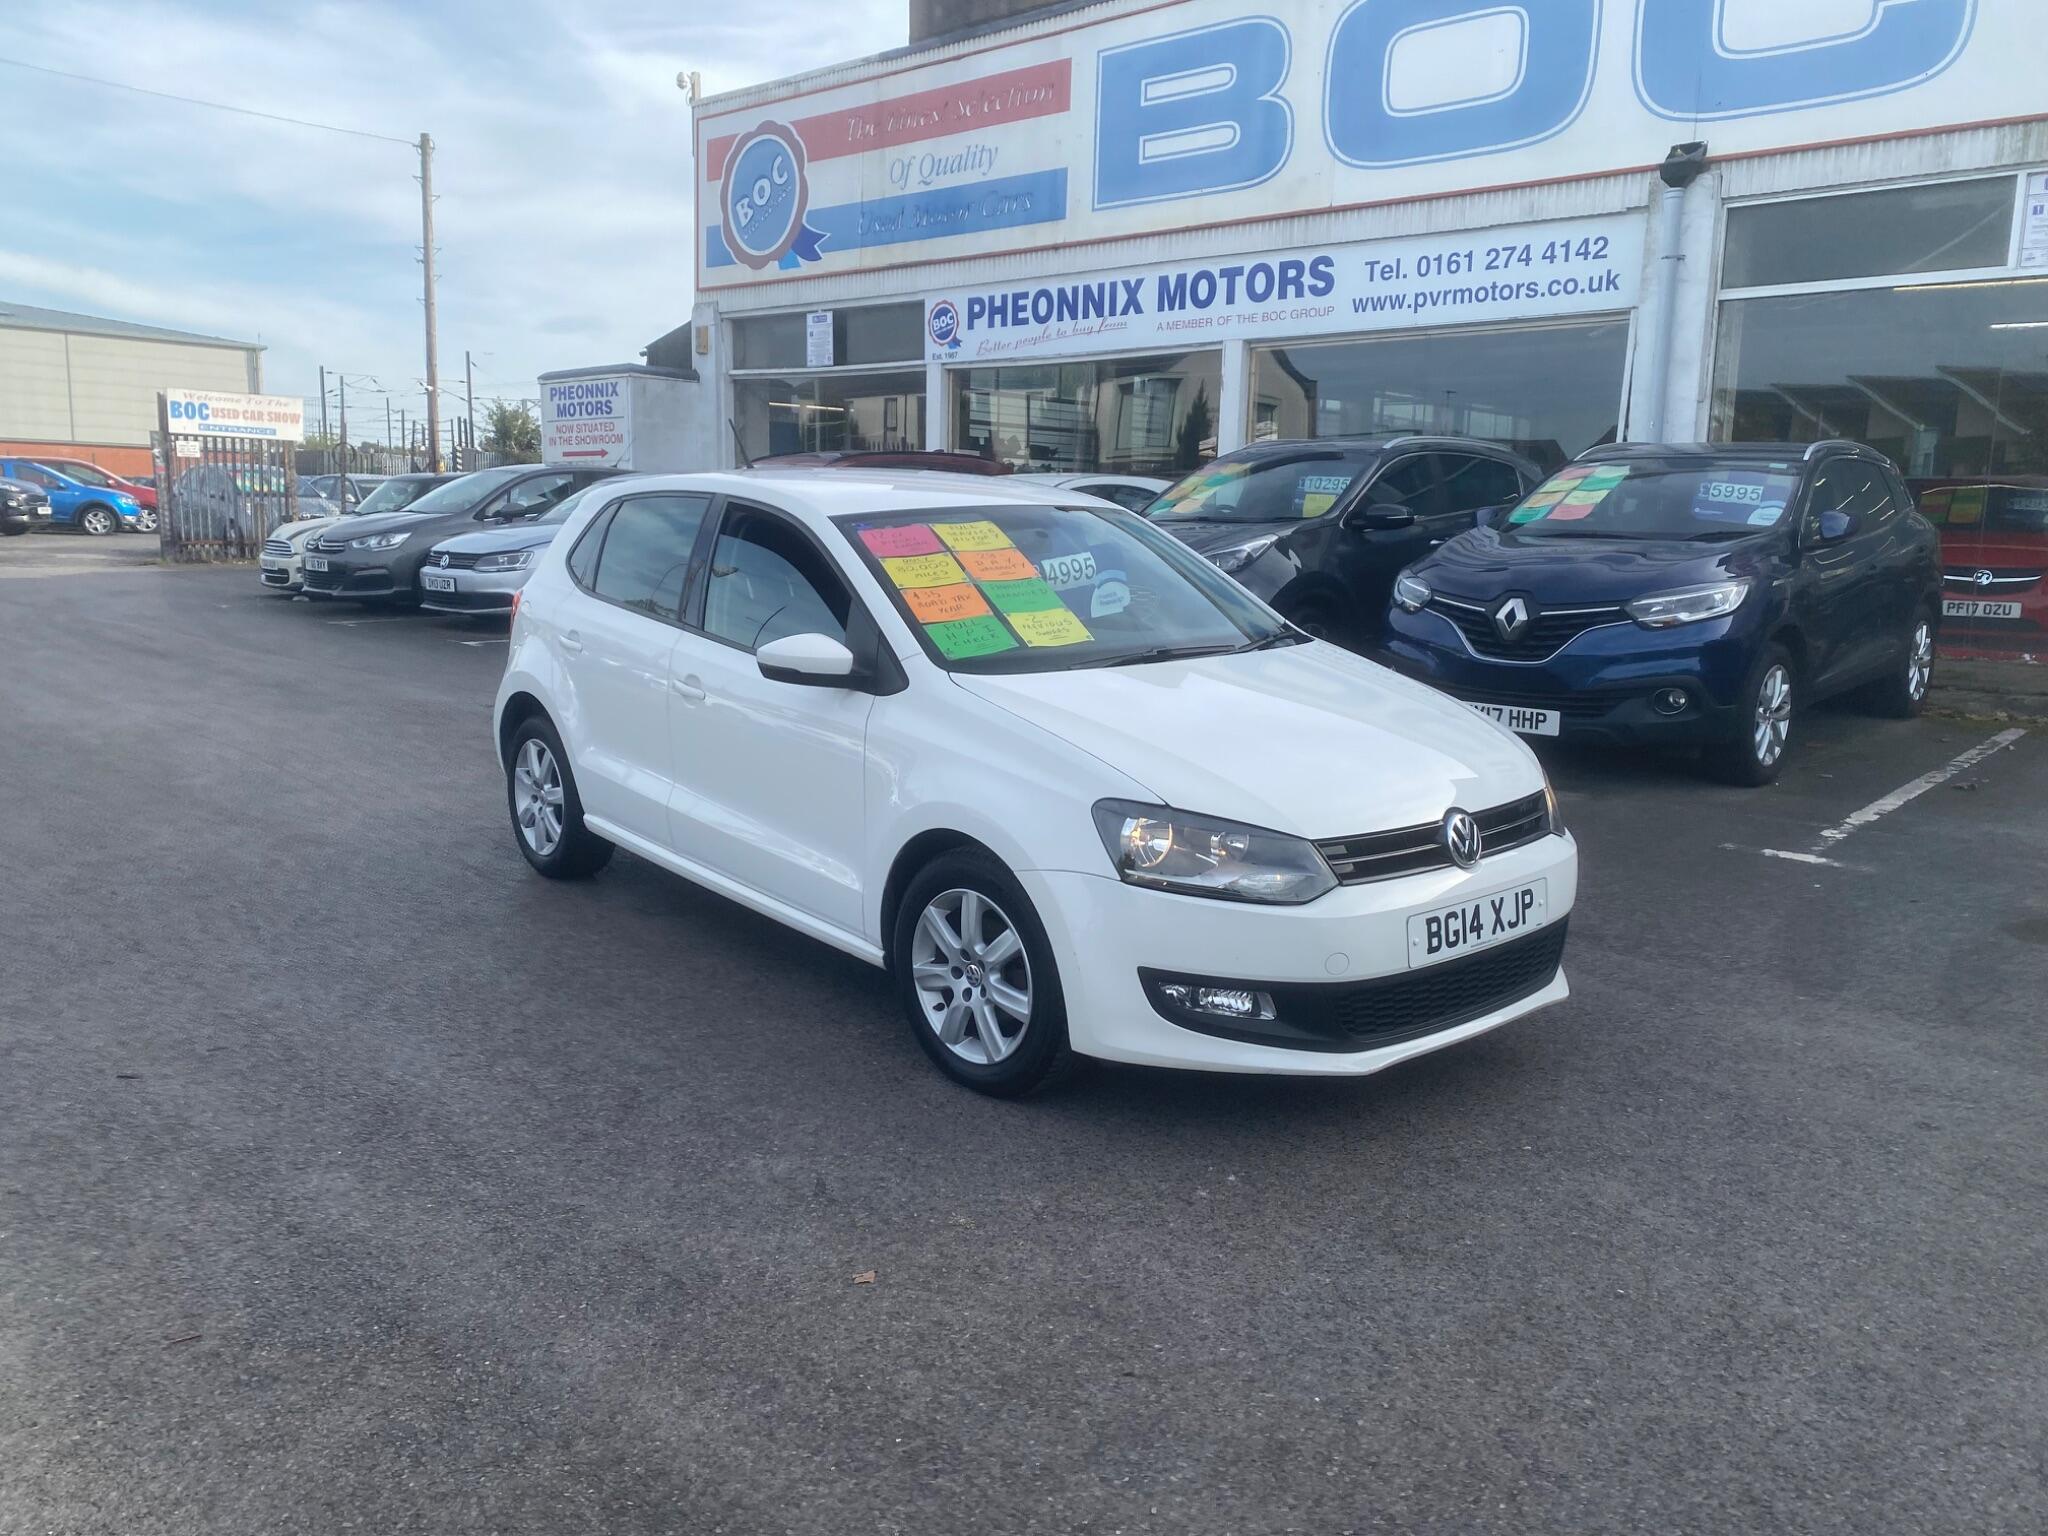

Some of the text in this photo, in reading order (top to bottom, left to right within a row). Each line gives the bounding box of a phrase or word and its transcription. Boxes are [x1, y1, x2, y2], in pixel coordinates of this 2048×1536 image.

[890, 144, 999, 190] Of Quality
[735, 154, 788, 228] BOC
[1365, 236, 1609, 282] Tel. 0161 274 4142
[966, 255, 1336, 331] PHEONNIX MOTORS
[1352, 268, 1621, 314] www.pvrmotors.co.uk
[933, 313, 954, 331] BOC
[1156, 305, 1335, 331] A MEMBER OF THE BOC GROUP
[1056, 327, 1067, 338] to
[183, 391, 290, 407] Welcome To The
[549, 382, 619, 401] PHEONNIX
[169, 400, 301, 425] BOC USED CAR SHOW
[556, 400, 613, 418] MOTORS
[556, 422, 615, 434] NOW SITUATED
[549, 434, 624, 446] IN THE SHOWROOM
[1508, 709, 1547, 729] HHP
[1425, 888, 1534, 955] BG14 XJP
